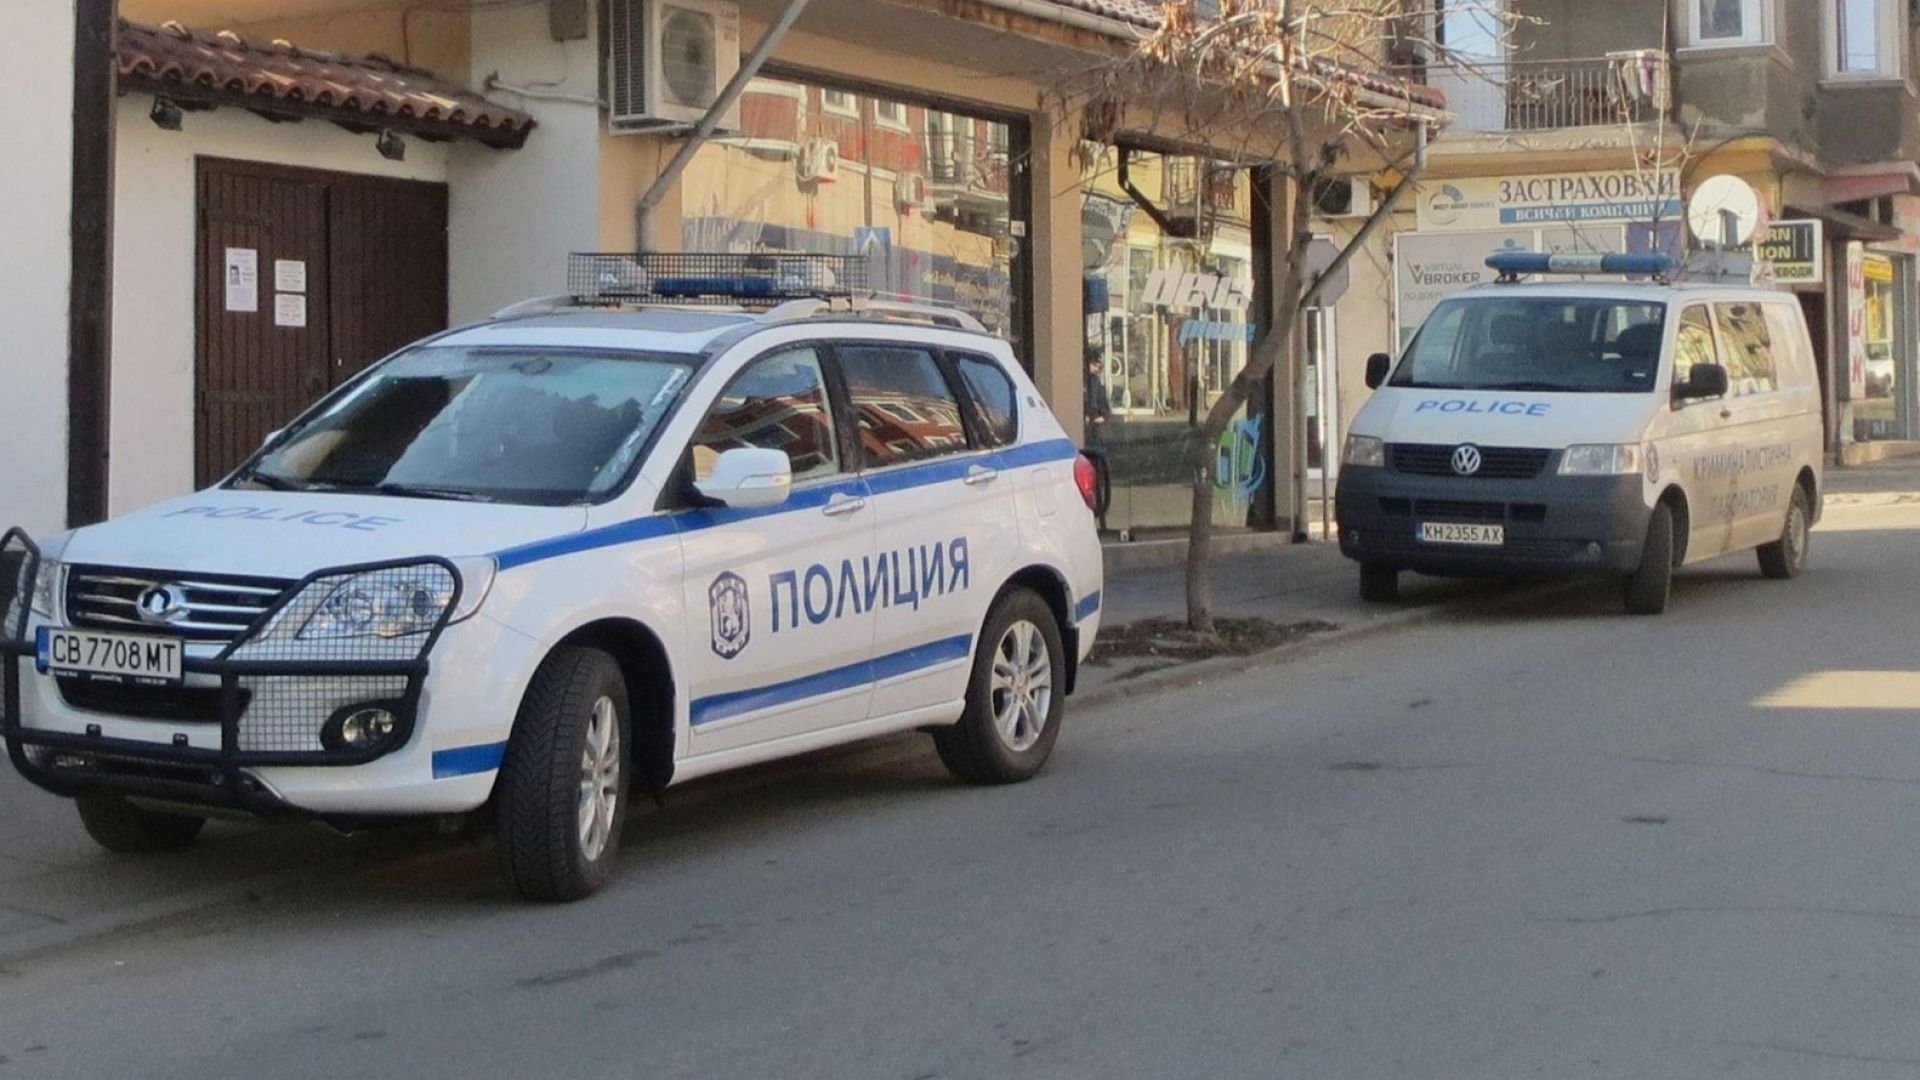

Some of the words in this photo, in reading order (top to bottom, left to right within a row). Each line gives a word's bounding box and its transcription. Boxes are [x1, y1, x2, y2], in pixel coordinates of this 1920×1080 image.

[1499, 173, 1675, 204] ЗАСТРАХОВКИ
[1515, 207, 1575, 222] ВСИЧКИ
[1423, 271, 1481, 285] BROKER
[1414, 400, 1552, 416] POLICE
[161, 506, 403, 531] POLICE
[768, 536, 970, 633] ПОЛИЦИЯ
[53, 634, 81, 664] CB
[86, 637, 142, 670] 7708
[146, 642, 176, 673] MT
